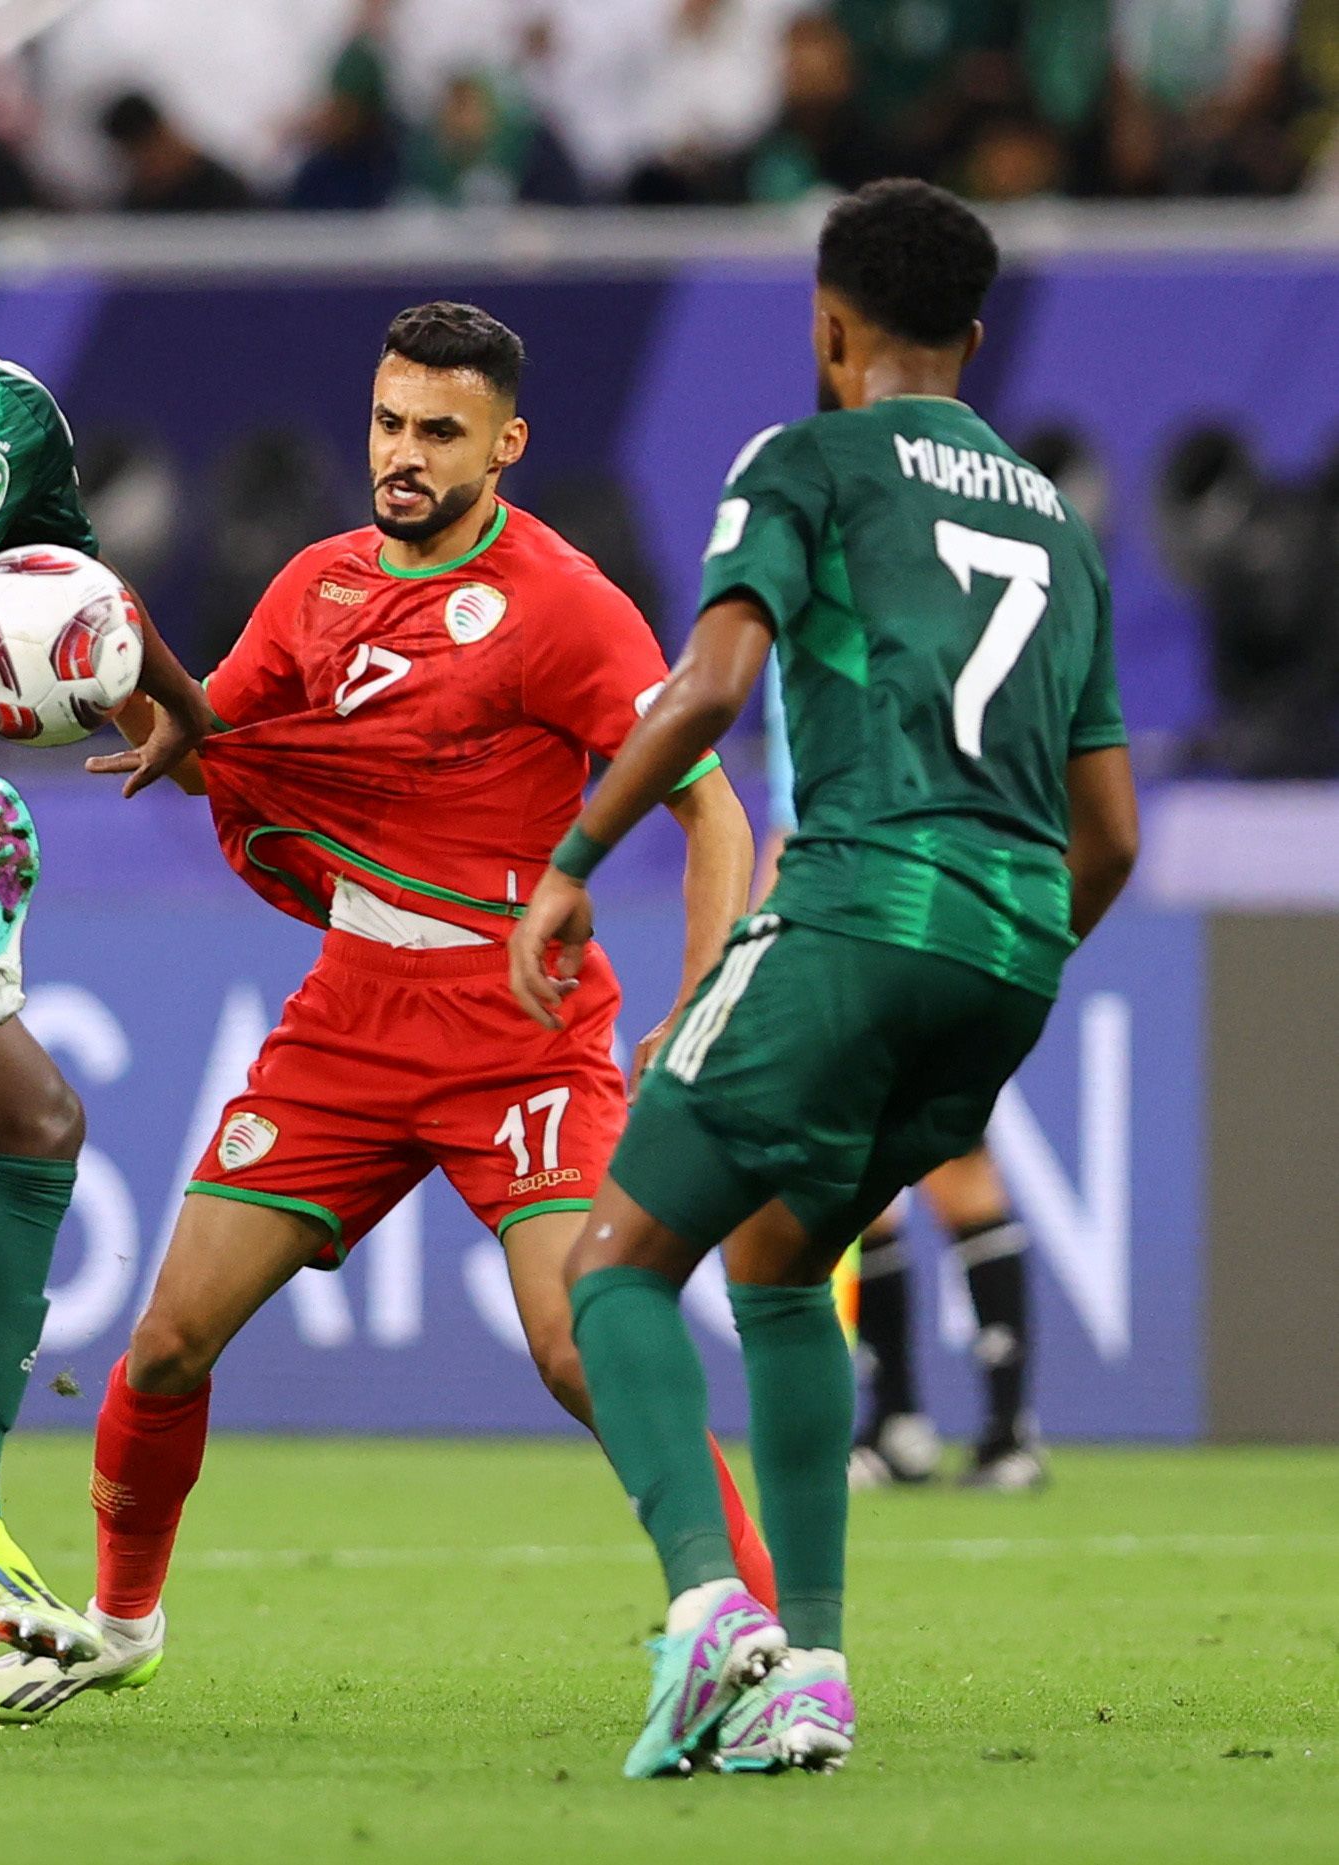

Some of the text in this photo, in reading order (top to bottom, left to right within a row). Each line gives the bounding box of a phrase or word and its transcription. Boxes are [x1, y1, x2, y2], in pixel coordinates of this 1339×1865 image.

[893, 433, 1066, 522] MUKHTAR
[335, 643, 412, 718] 17
[934, 519, 1051, 760] 7
[494, 1086, 571, 1178] 17
